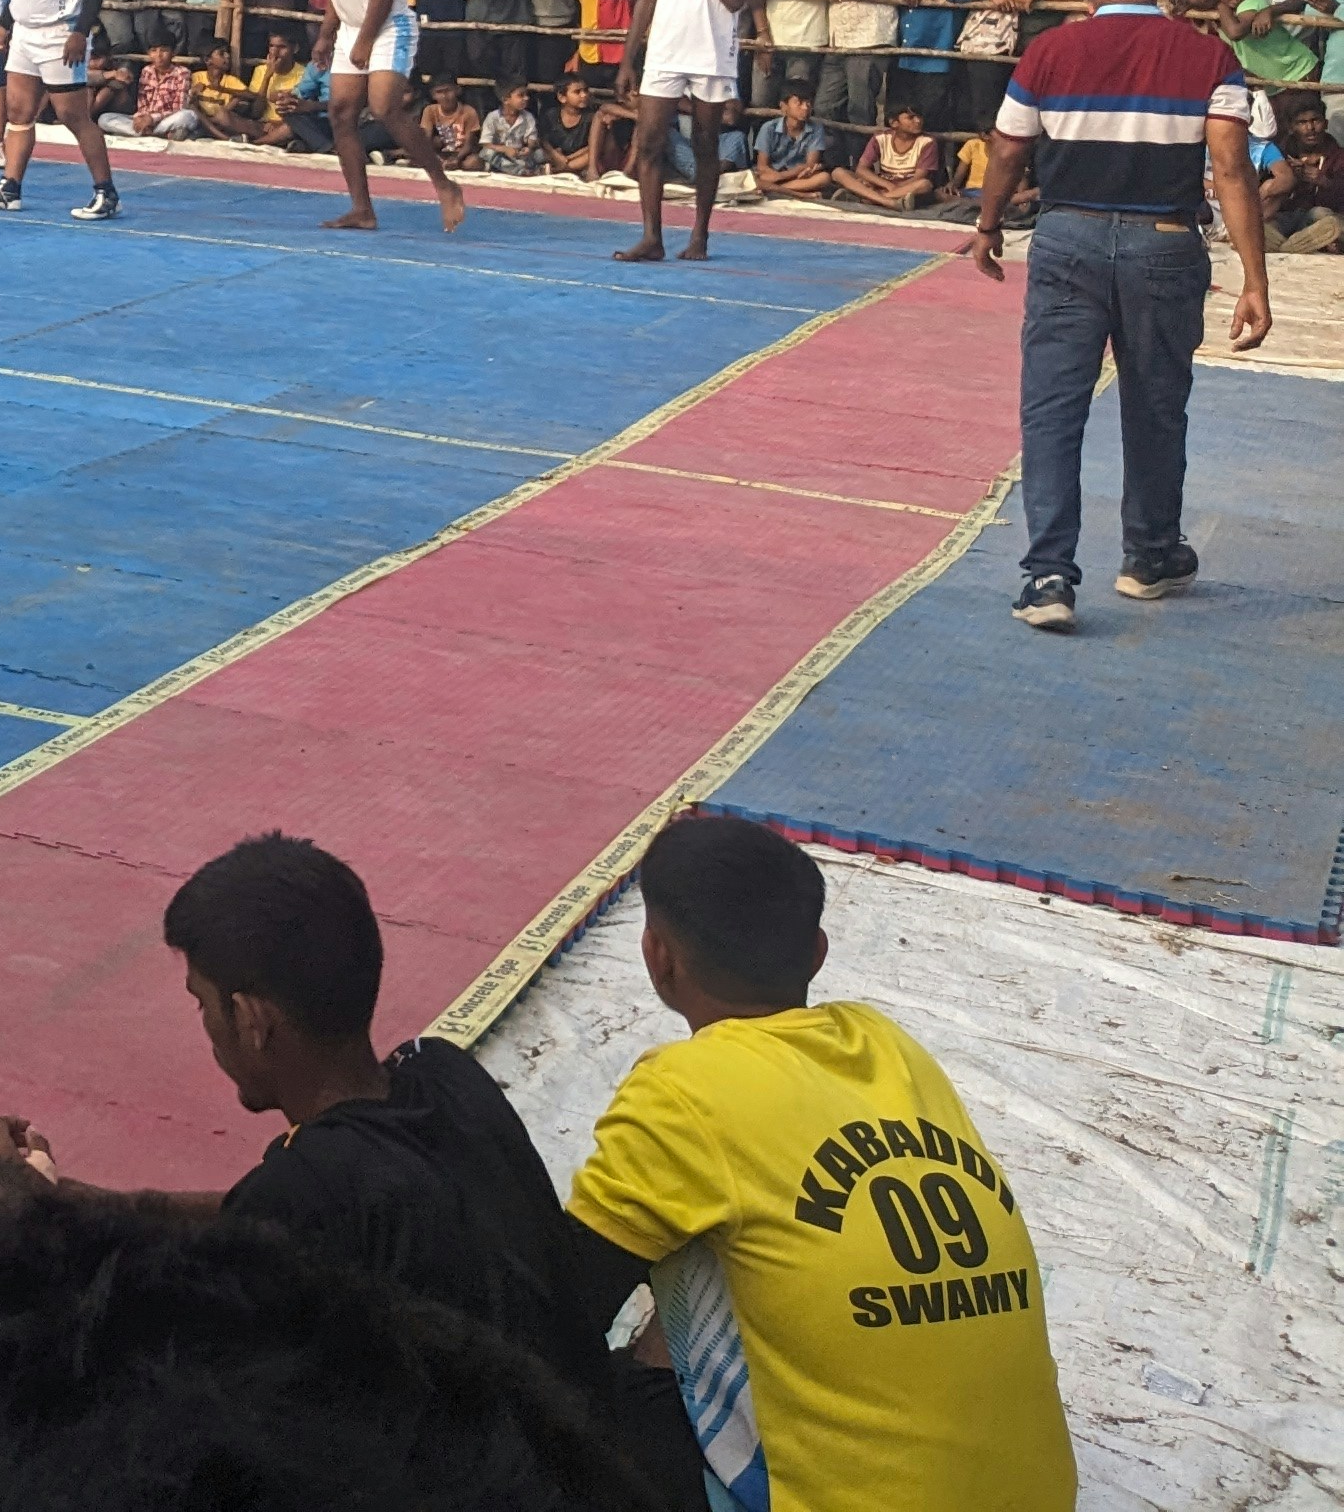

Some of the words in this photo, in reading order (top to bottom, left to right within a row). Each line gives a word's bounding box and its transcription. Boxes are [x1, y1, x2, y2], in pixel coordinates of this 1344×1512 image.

[594, 839, 635, 870] Concrete
[624, 822, 654, 847] Tape
[526, 902, 572, 938] Concrete
[558, 884, 591, 912] Tape
[454, 978, 499, 1020] Concrete
[486, 958, 520, 986] Tape
[795, 1116, 1015, 1233] KABADDI
[869, 1171, 990, 1274] 09
[848, 1269, 1031, 1328] SWAMY
